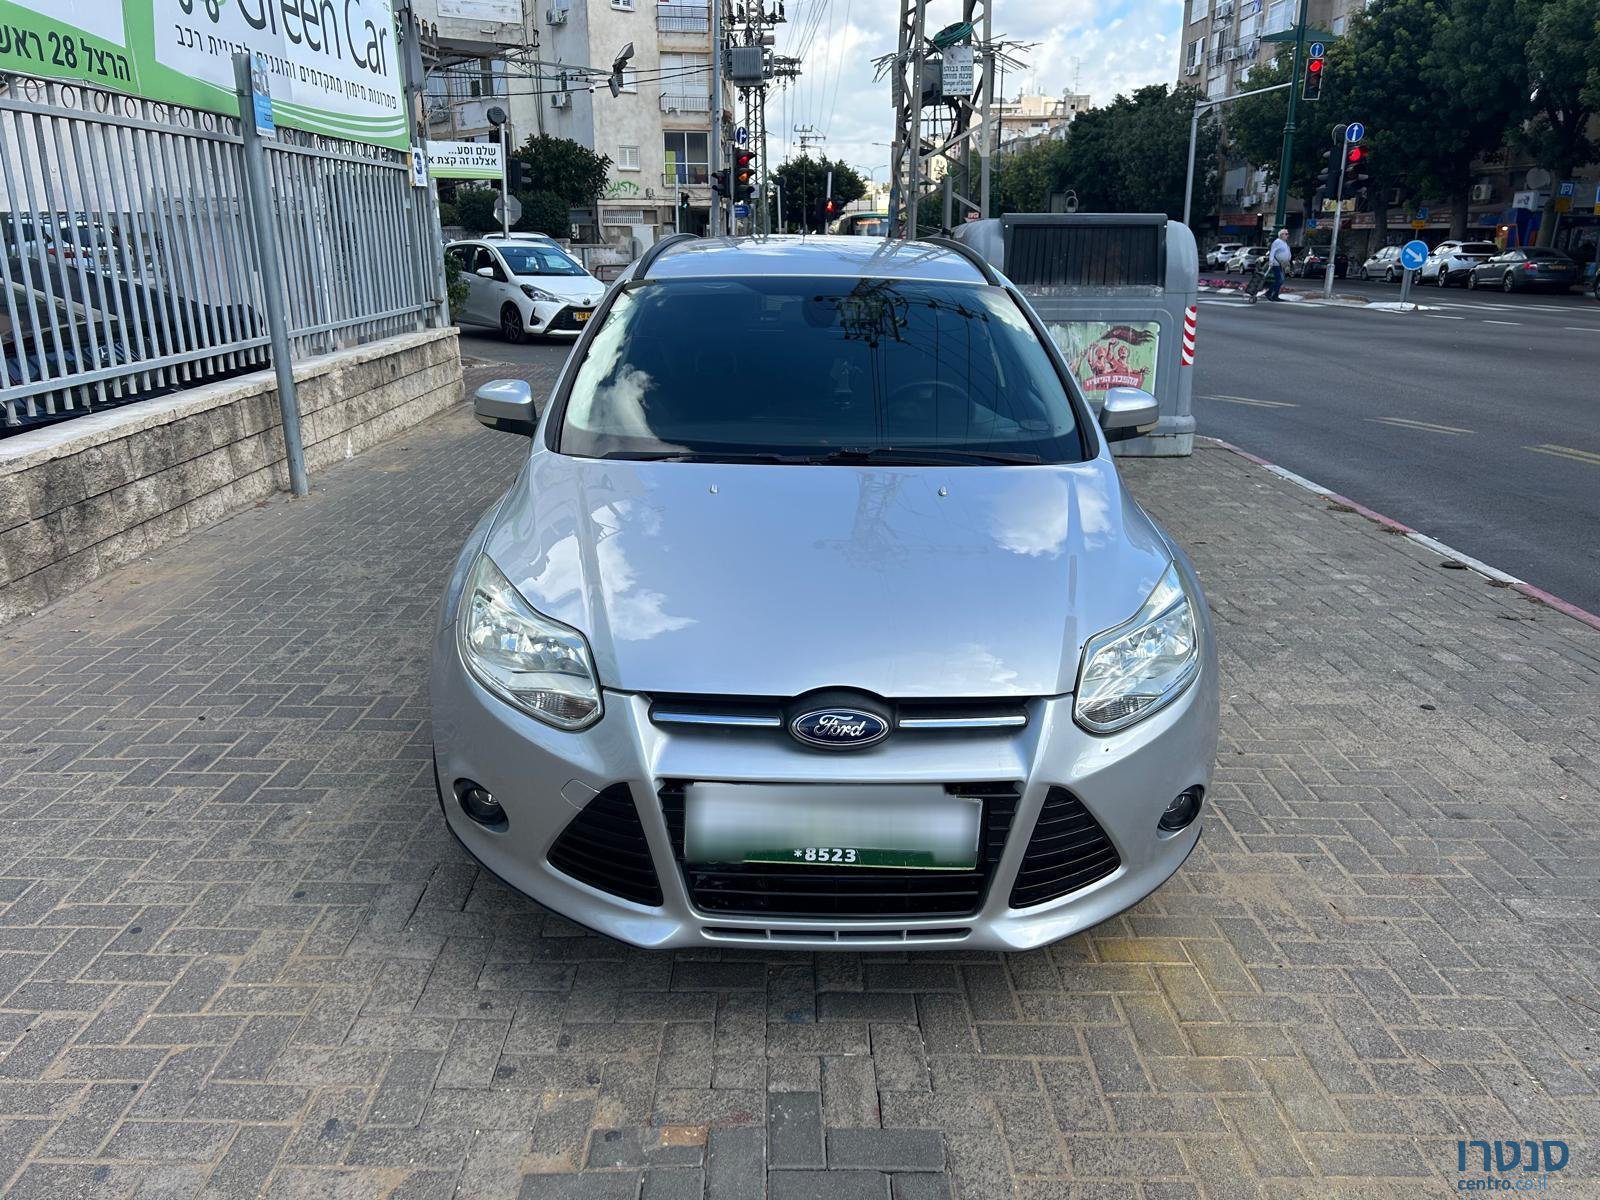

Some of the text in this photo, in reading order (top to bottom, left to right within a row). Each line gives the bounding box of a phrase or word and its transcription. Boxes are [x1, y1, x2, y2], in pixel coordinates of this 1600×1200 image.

[175, 24, 204, 52] רכב
[344, 0, 388, 77] Car
[48, 31, 78, 69] 28
[80, 37, 131, 82] הרצל
[299, 65, 343, 94] מתקדמים
[344, 79, 367, 101] מימון
[368, 88, 397, 110] פתרונות
[437, 156, 457, 167] קצת
[459, 156, 470, 166] זה
[472, 156, 497, 166] אצלנו
[476, 145, 496, 156] שלם
[813, 714, 867, 737] Ford
